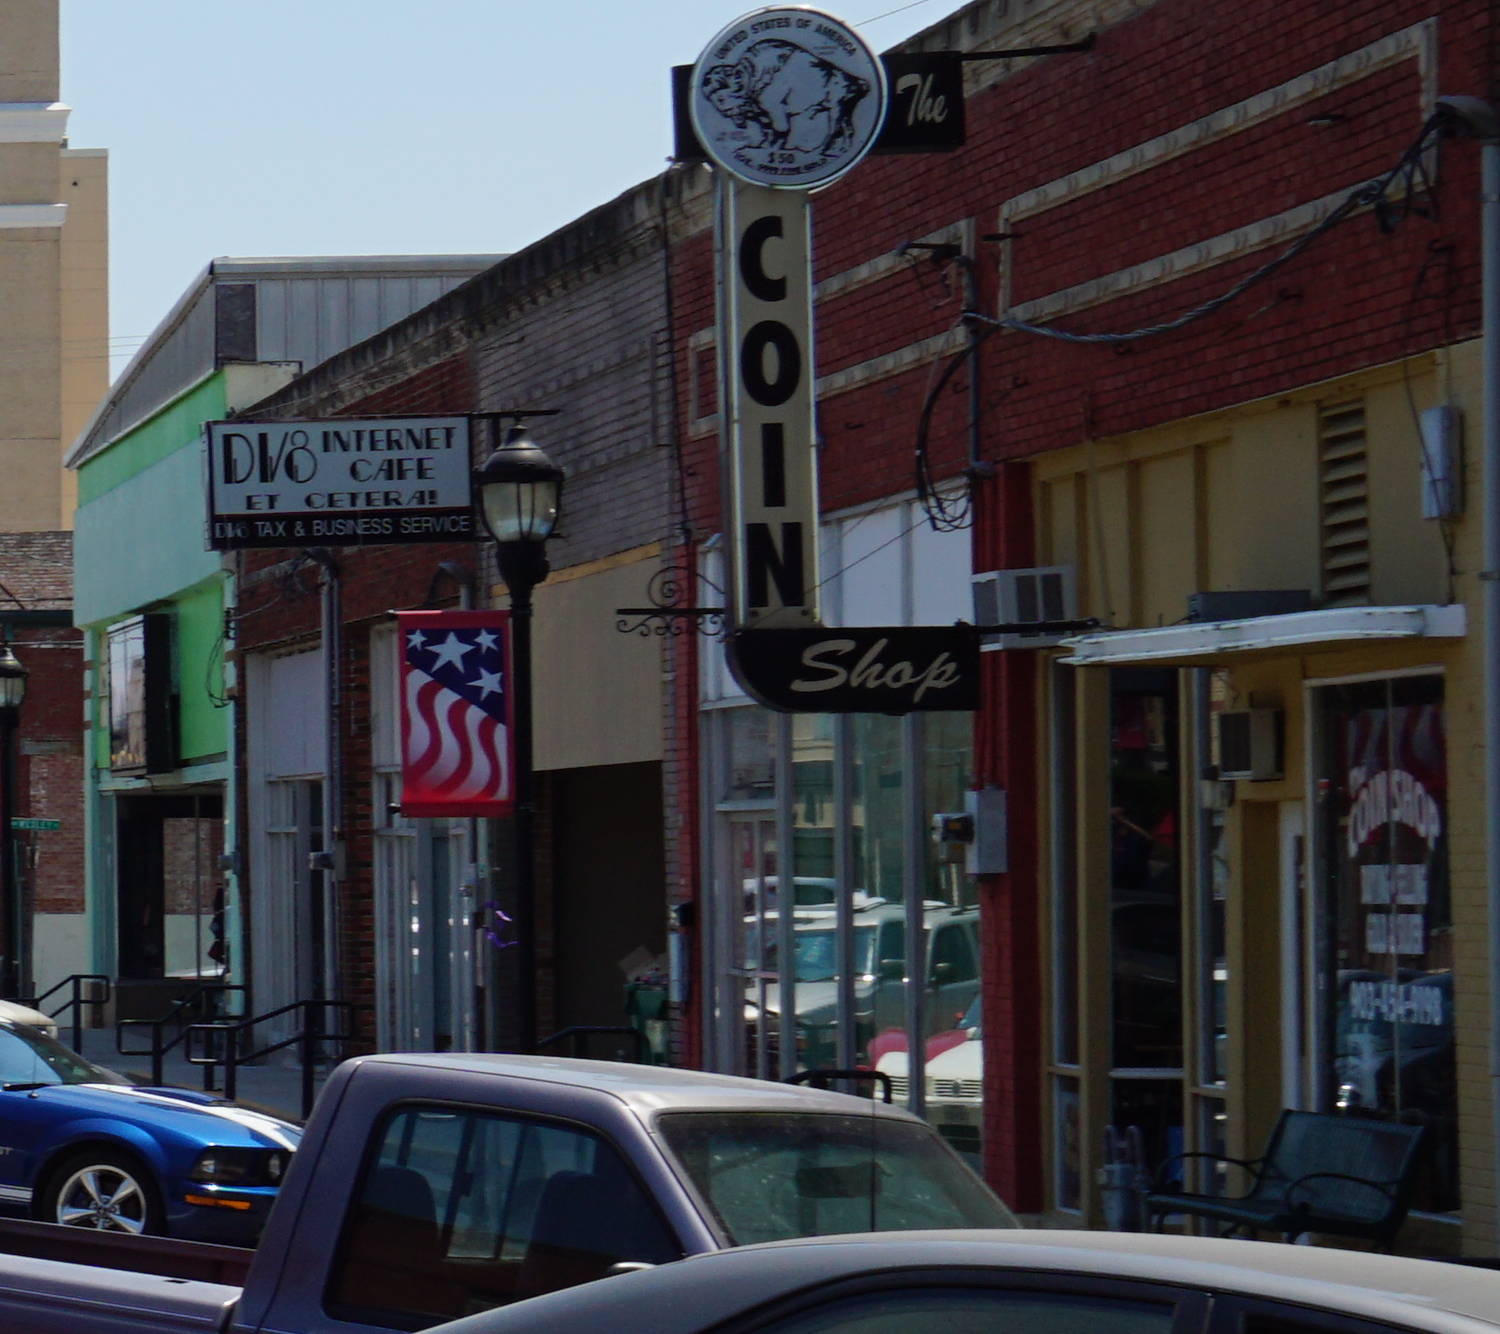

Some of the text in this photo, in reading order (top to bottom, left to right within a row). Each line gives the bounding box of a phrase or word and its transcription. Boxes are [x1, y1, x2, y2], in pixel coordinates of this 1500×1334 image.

[715, 30, 749, 60] UNITED
[751, 18, 792, 35] STATES
[796, 18, 812, 29] OF
[814, 23, 857, 57] AMERICA
[896, 73, 948, 127] The
[739, 215, 805, 608] COIN
[322, 426, 457, 454] INTERNET
[350, 457, 436, 483] CAFE
[246, 489, 439, 511] ET CETERA!
[255, 520, 287, 538] TAX
[294, 519, 306, 537] &
[312, 517, 394, 536] BUSINESS
[401, 515, 471, 534] SERVICE
[790, 638, 962, 704] Shop
